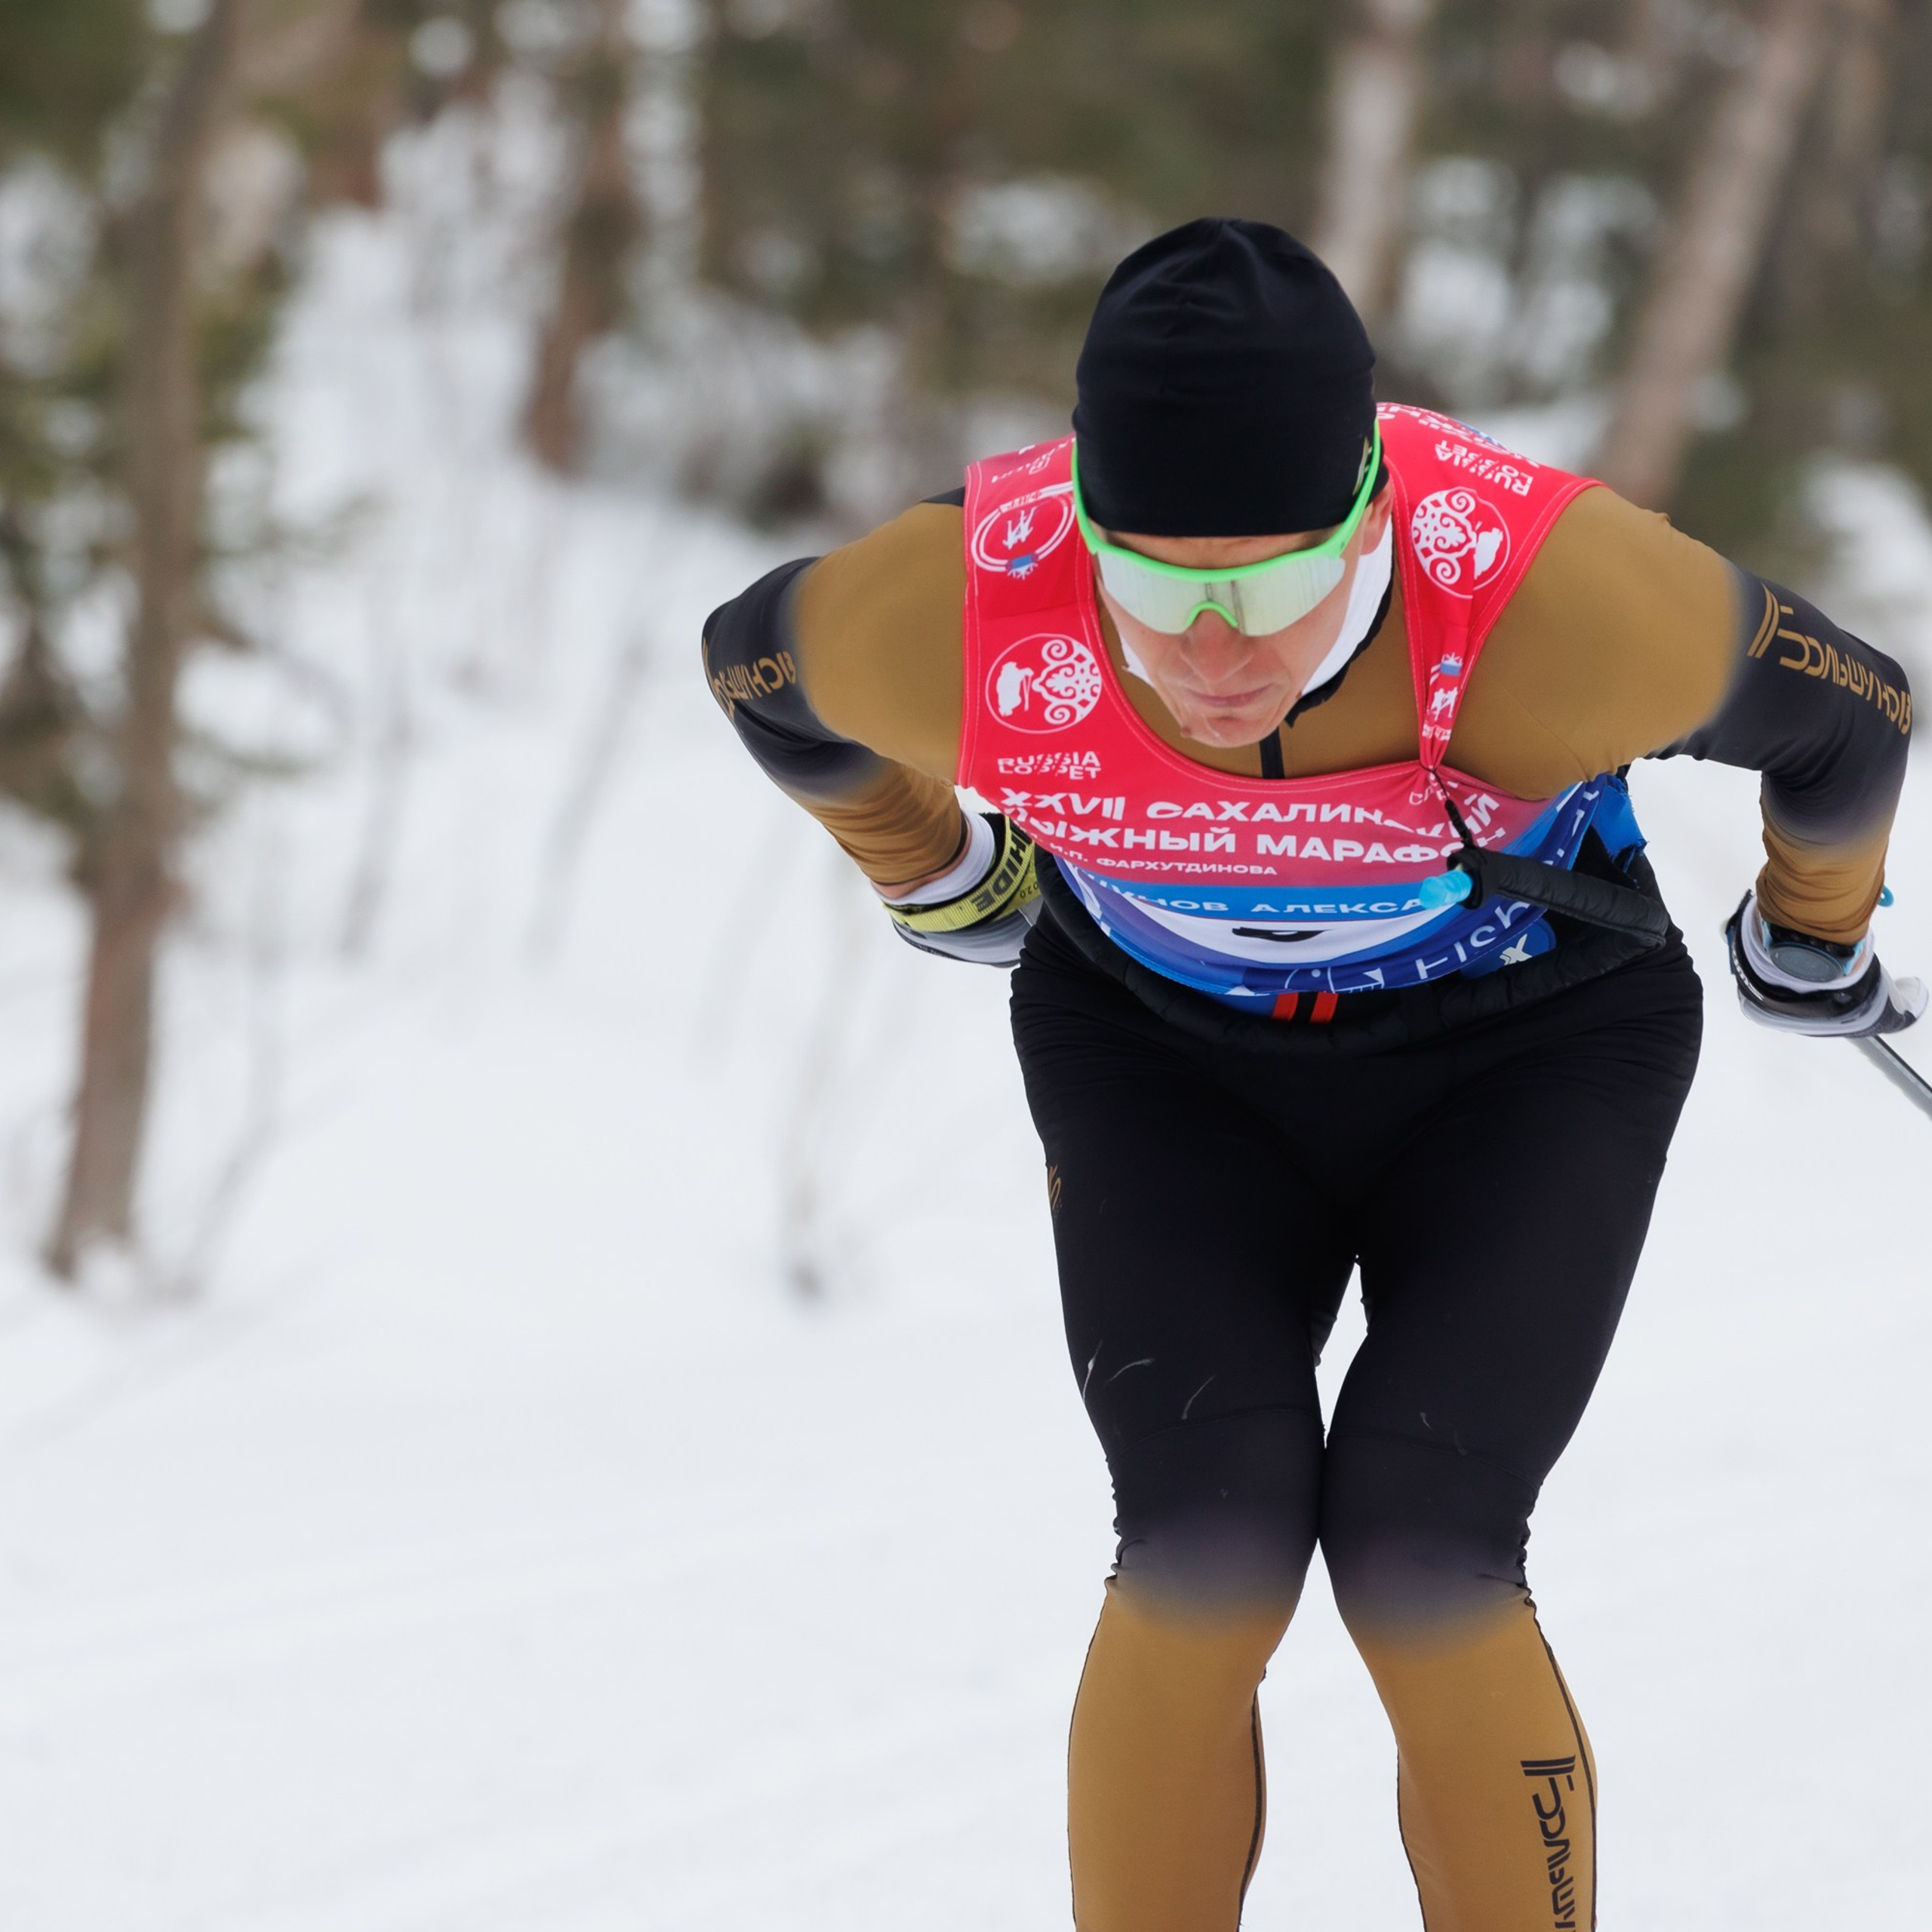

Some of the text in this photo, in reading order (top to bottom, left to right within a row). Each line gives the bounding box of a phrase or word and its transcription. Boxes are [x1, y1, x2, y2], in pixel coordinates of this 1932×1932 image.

[1435, 443, 1532, 496] RUSSIA
[997, 751, 1101, 767] RUSSIA
[998, 764, 1102, 780] LOPPET
[1097, 857, 1277, 875] ФАРХУТДИНОВА
